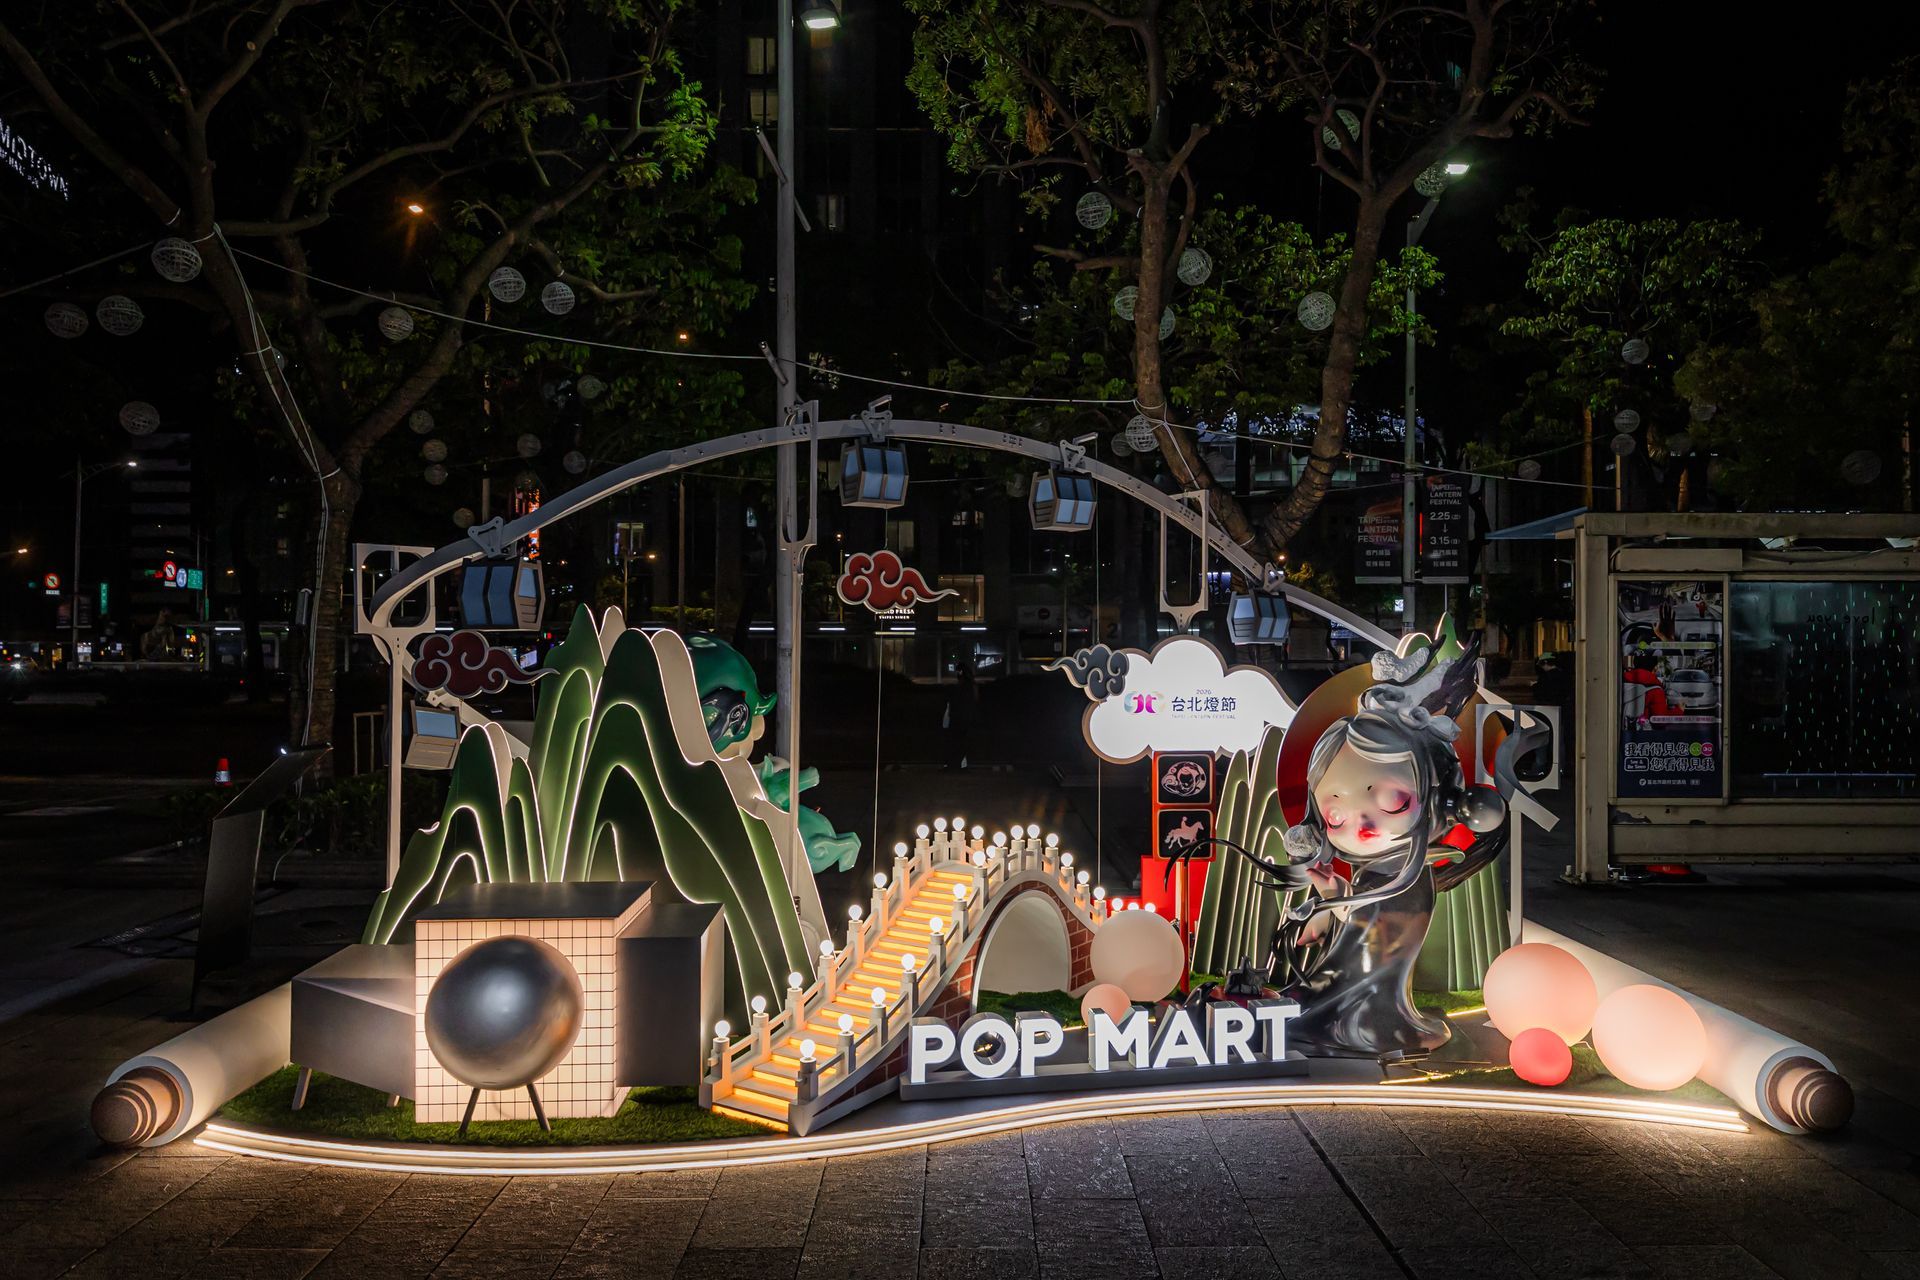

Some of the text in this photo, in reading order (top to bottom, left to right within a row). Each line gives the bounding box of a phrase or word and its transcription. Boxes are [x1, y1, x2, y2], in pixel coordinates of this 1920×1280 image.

[1357, 516, 1383, 524] TAIPEI
[1357, 525, 1399, 534] LANTERN
[1357, 535, 1399, 543] FESTIVAL
[1171, 696, 1237, 712] 台北燈節
[1624, 741, 1690, 757] 我看得見您
[1649, 757, 1715, 772] 您看得見我
[909, 1004, 1301, 1084] POP MART
